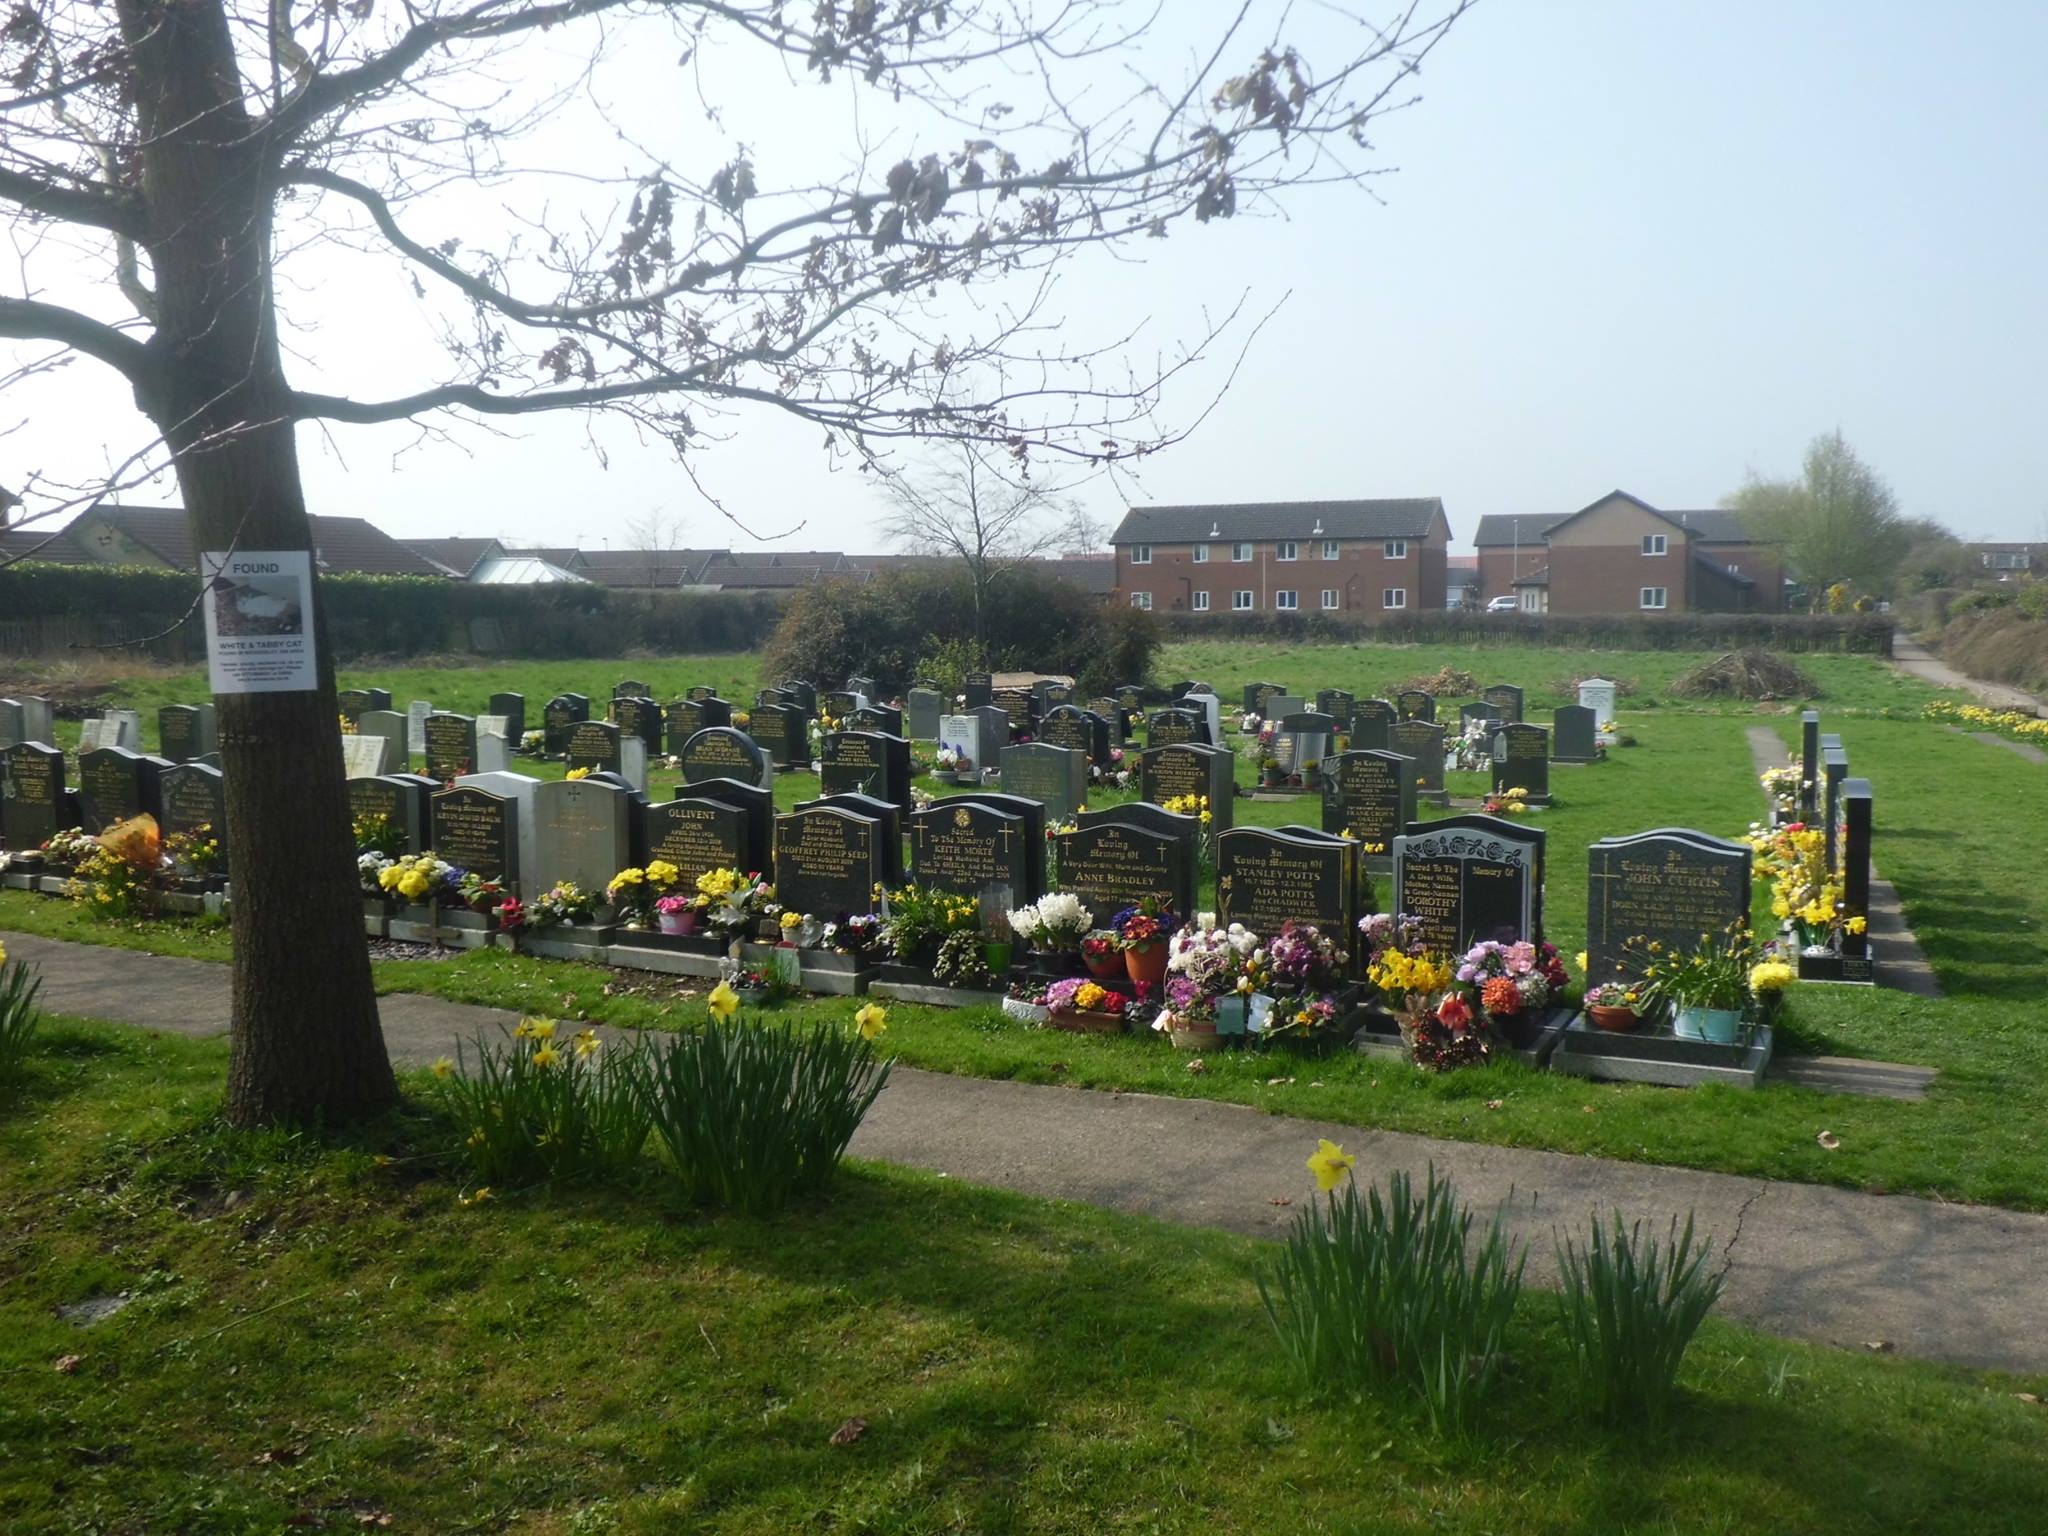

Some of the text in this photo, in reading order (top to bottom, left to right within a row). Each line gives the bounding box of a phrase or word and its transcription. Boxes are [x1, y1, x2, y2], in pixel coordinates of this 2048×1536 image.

[233, 563, 279, 573] FOUND
[668, 808, 716, 819] OLLIVENT
[681, 822, 703, 830] JOHN
[815, 817, 842, 828] Loving
[1107, 829, 1120, 838] In
[931, 835, 995, 847] To The Memory Of
[1098, 839, 1128, 849] Loving
[779, 846, 868, 859] GEOFFREY PHILIP SEED
[935, 845, 993, 856] KEITH MORTE
[1090, 849, 1139, 860] Memory Of
[1270, 848, 1282, 857] In
[942, 861, 965, 869] SHEILA
[1233, 855, 1266, 867] Loving
[1269, 857, 1308, 870] Memory
[1406, 862, 1458, 874] Sacred To The
[1621, 860, 1658, 872] Loving
[1664, 863, 1707, 875] Memory
[1235, 868, 1320, 880] STANLEY POTTS
[1472, 866, 1515, 877] Memory Of
[1107, 873, 1155, 885] BRADLEY
[1626, 873, 1721, 888] JOHN CURTIS
[1255, 888, 1315, 899] ADA POTTS
[1267, 898, 1316, 908] CHADWICK
[1407, 896, 1457, 907] DOROTHY
[1414, 907, 1449, 917] WHITE
